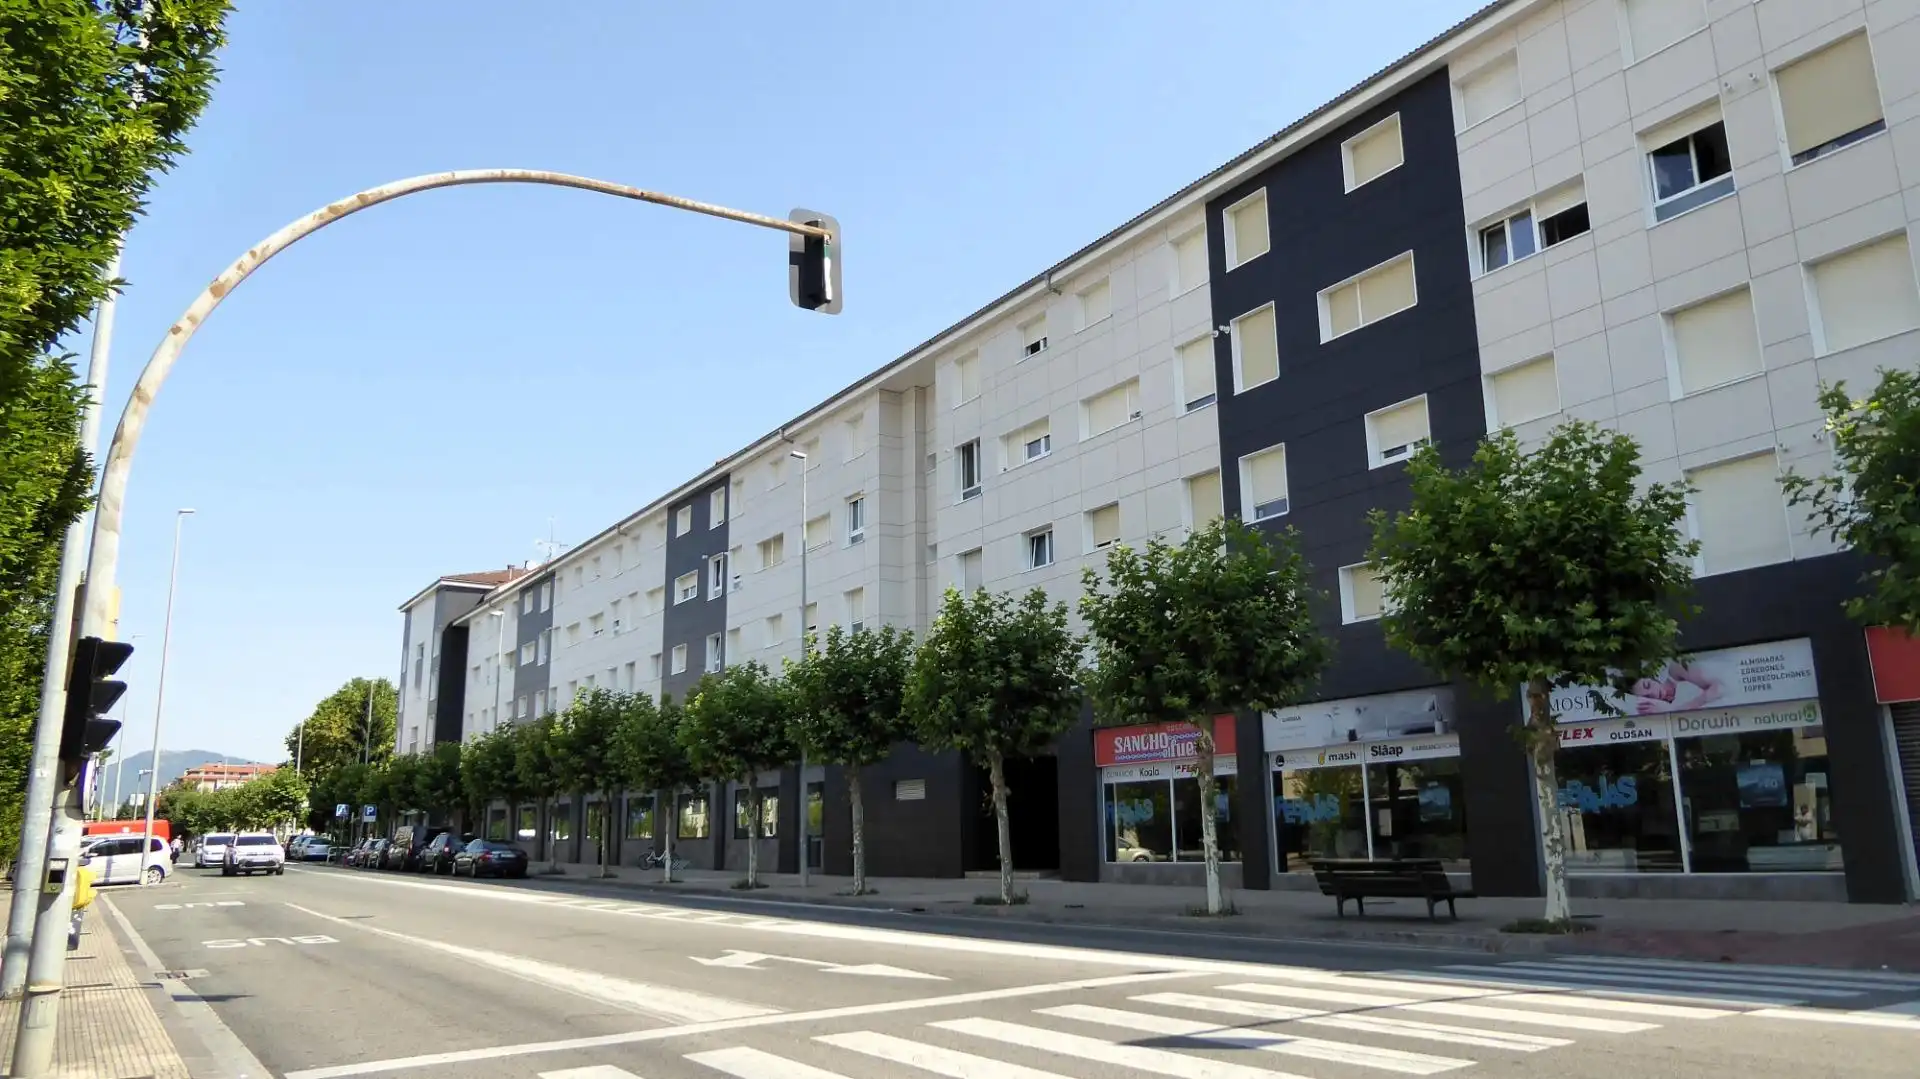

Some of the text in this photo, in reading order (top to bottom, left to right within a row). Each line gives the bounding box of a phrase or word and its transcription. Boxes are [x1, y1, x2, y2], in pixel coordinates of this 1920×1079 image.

[1740, 654, 1785, 666] ALMOHADAS
[1740, 663, 1785, 675] EDREDONES
[1744, 683, 1773, 693] TOPPER
[1678, 711, 1801, 732] Dorwin natural
[1610, 729, 1652, 741] OLDSAN
[1114, 732, 1169, 753] SANCHO
[1328, 751, 1356, 761] mash
[1371, 744, 1403, 757] Slâap
[1139, 764, 1160, 777] Koala
[200, 934, 341, 949] BUS
